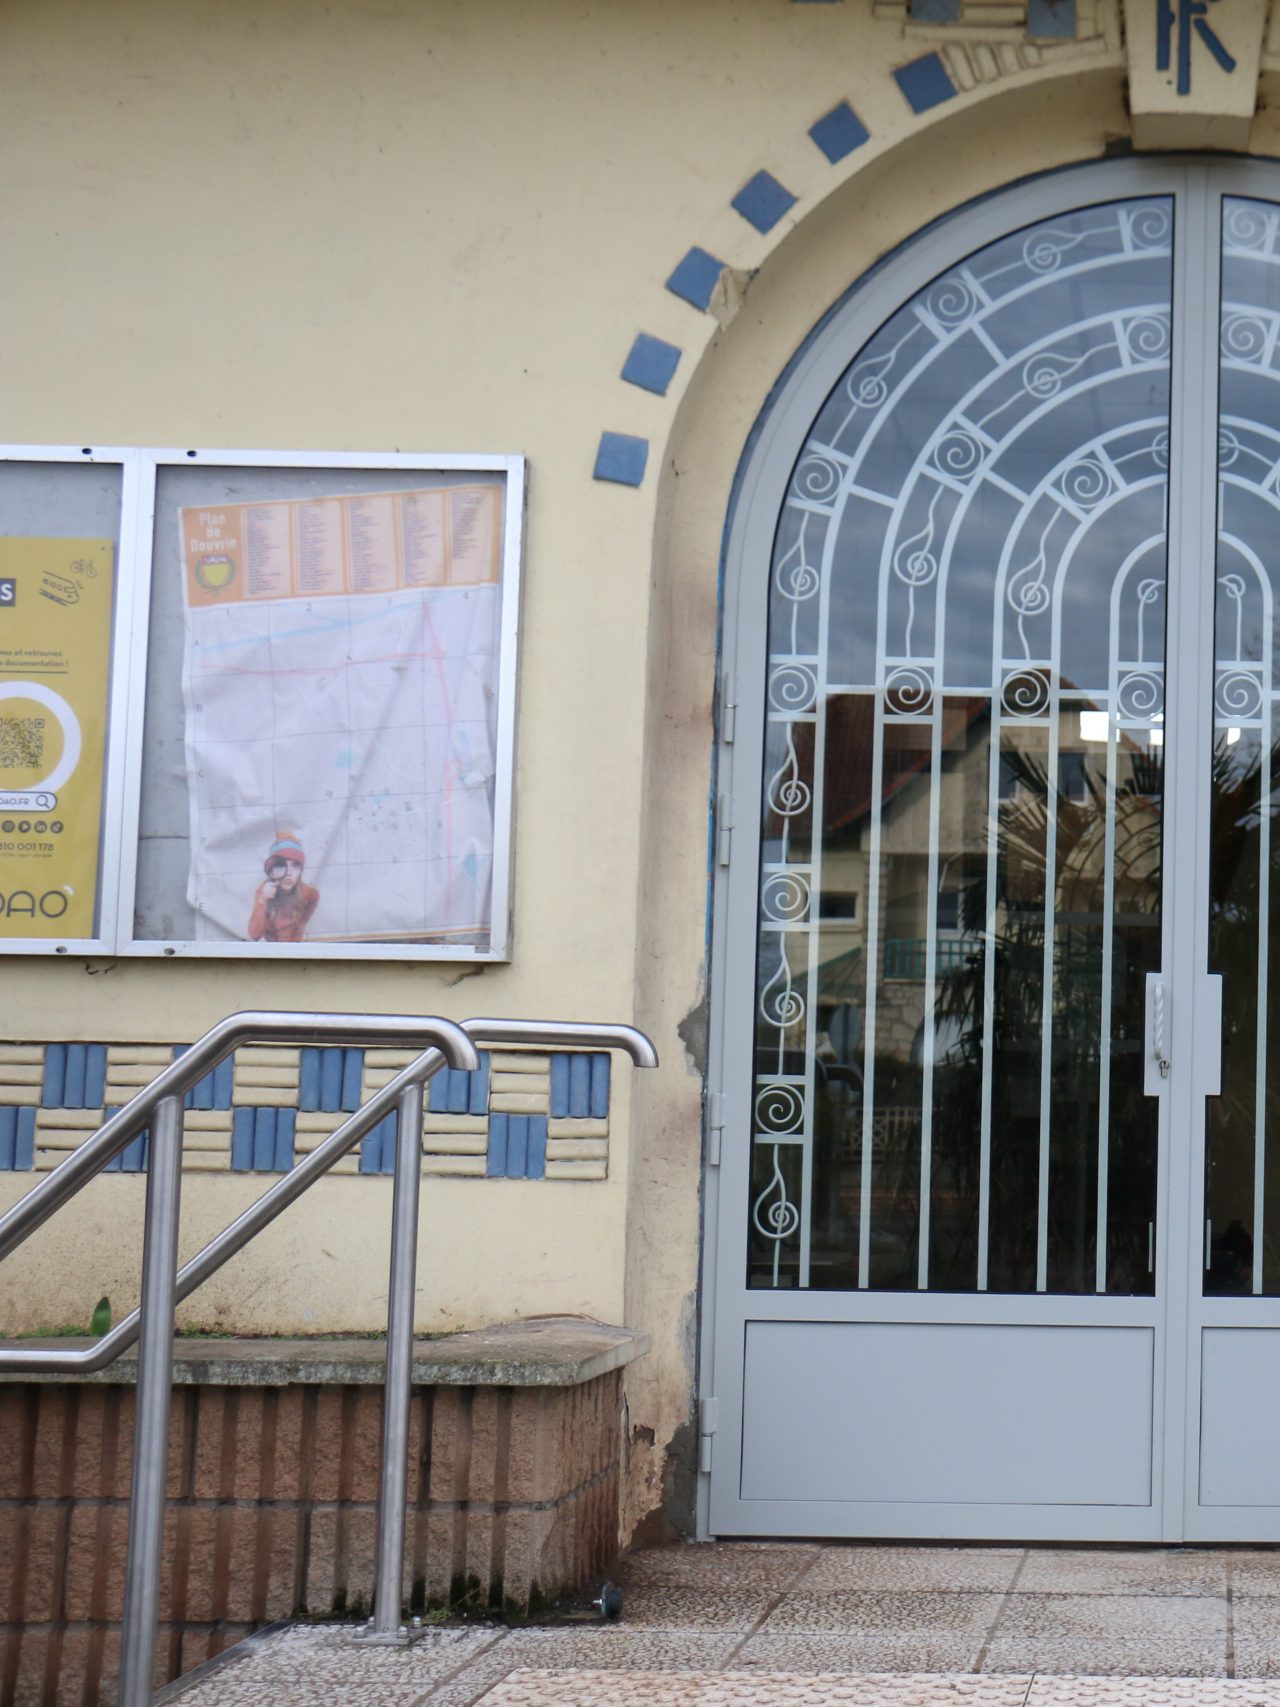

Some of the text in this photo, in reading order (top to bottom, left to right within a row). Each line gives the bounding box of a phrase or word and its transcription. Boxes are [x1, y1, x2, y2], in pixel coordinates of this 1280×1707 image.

[199, 511, 226, 526] Plan
[206, 527, 221, 538] de
[190, 538, 237, 552] Douvrin
[0, 583, 13, 601] S
[16, 842, 37, 851] 001
[0, 890, 68, 919] AO
